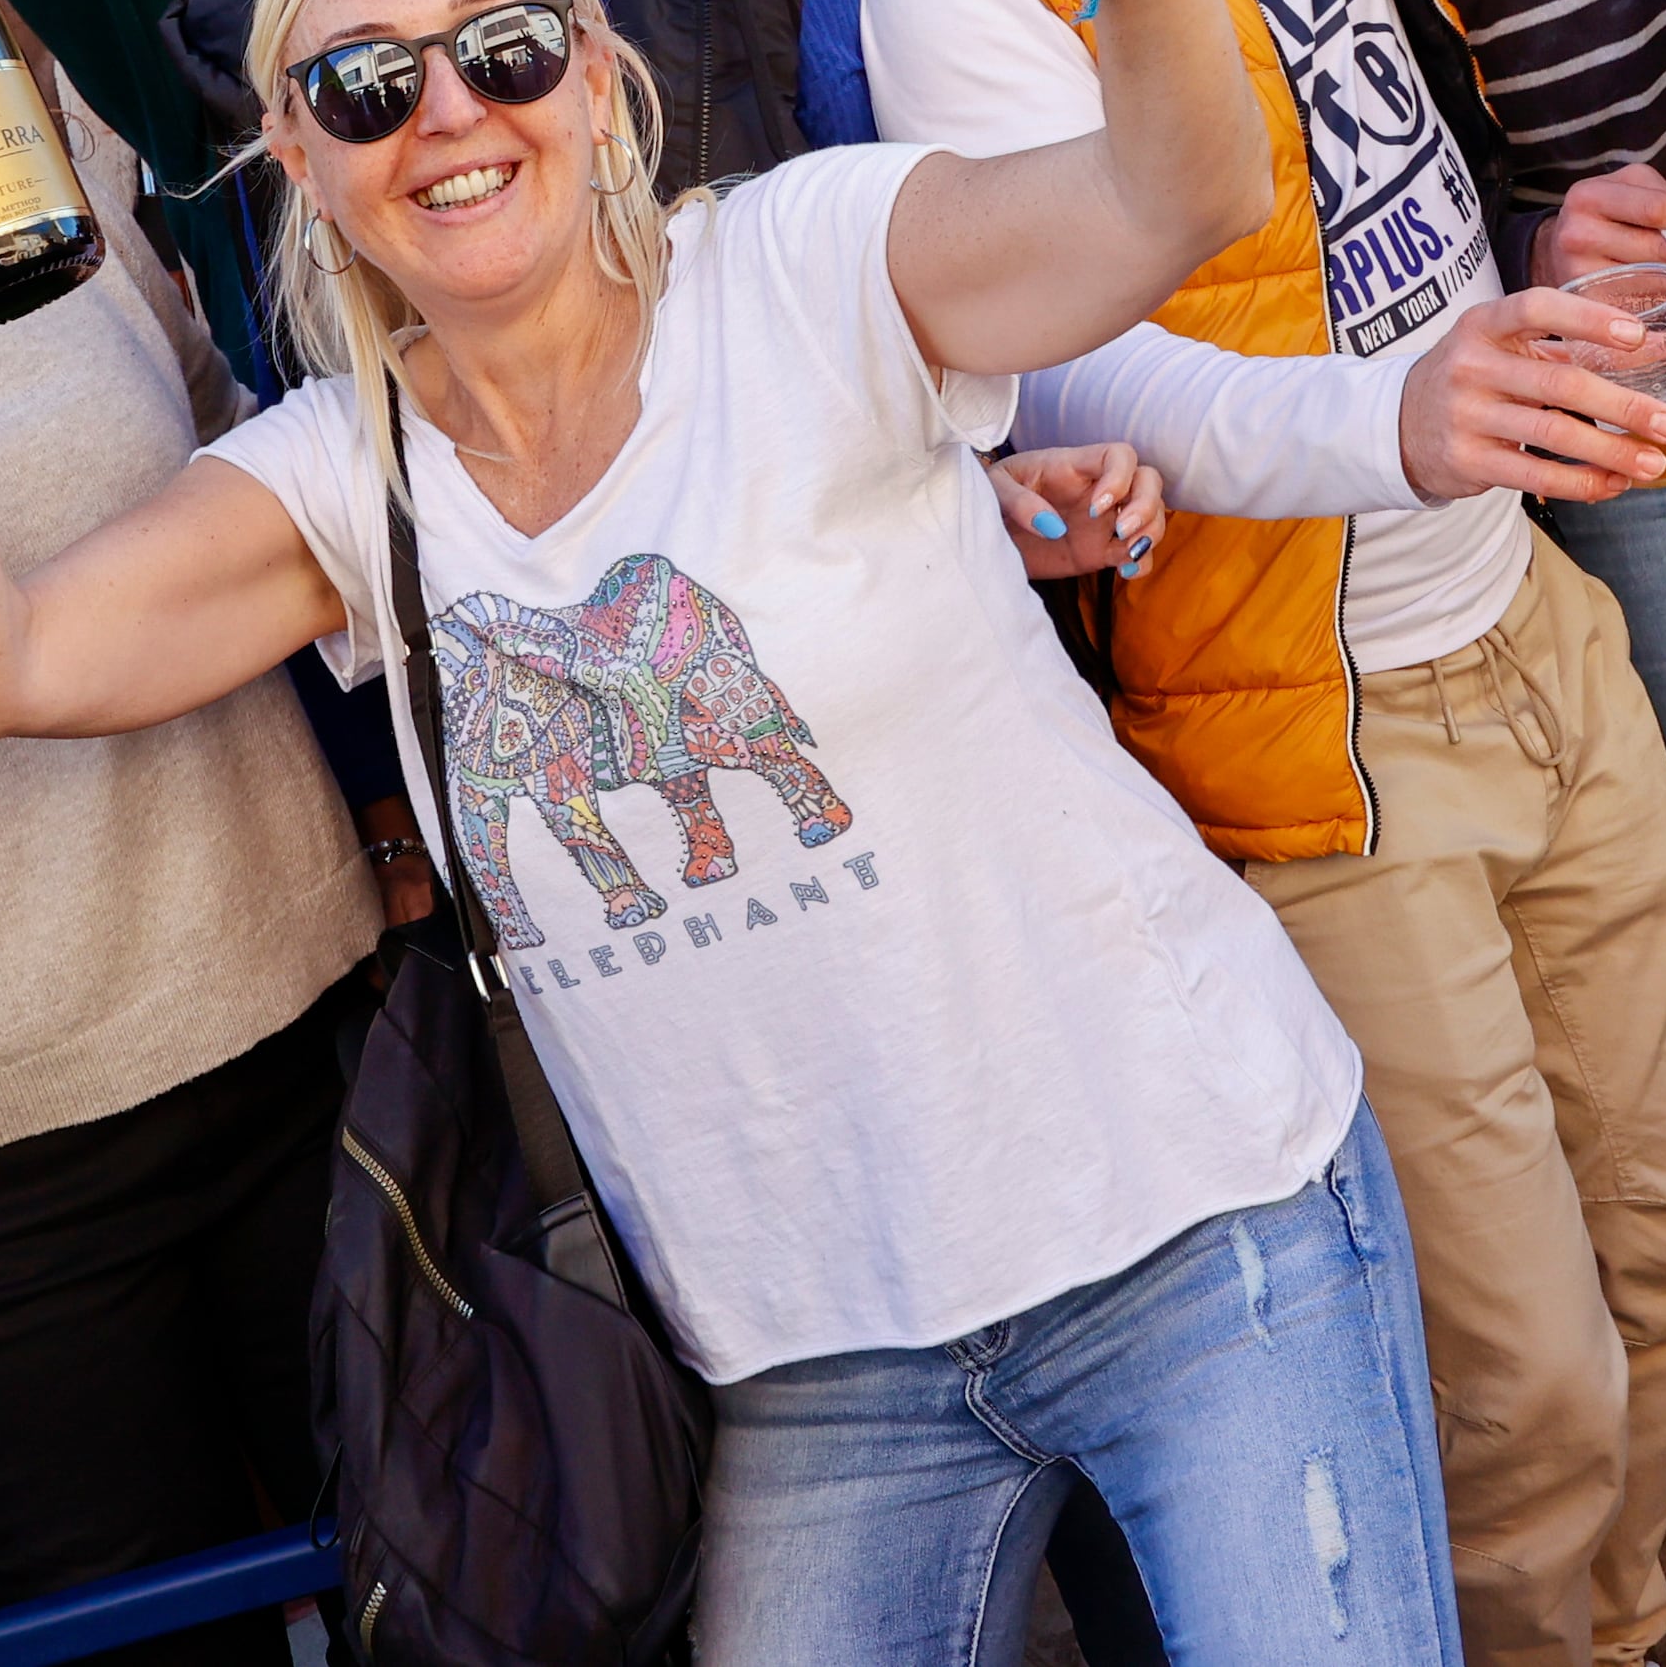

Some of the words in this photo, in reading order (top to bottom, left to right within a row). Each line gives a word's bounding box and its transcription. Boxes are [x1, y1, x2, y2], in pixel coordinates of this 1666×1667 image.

[1, 196, 42, 214] METHOD
[1357, 312, 1395, 356] NEW
[1397, 284, 1442, 338] YORK
[520, 852, 879, 995] ELEPHANT
